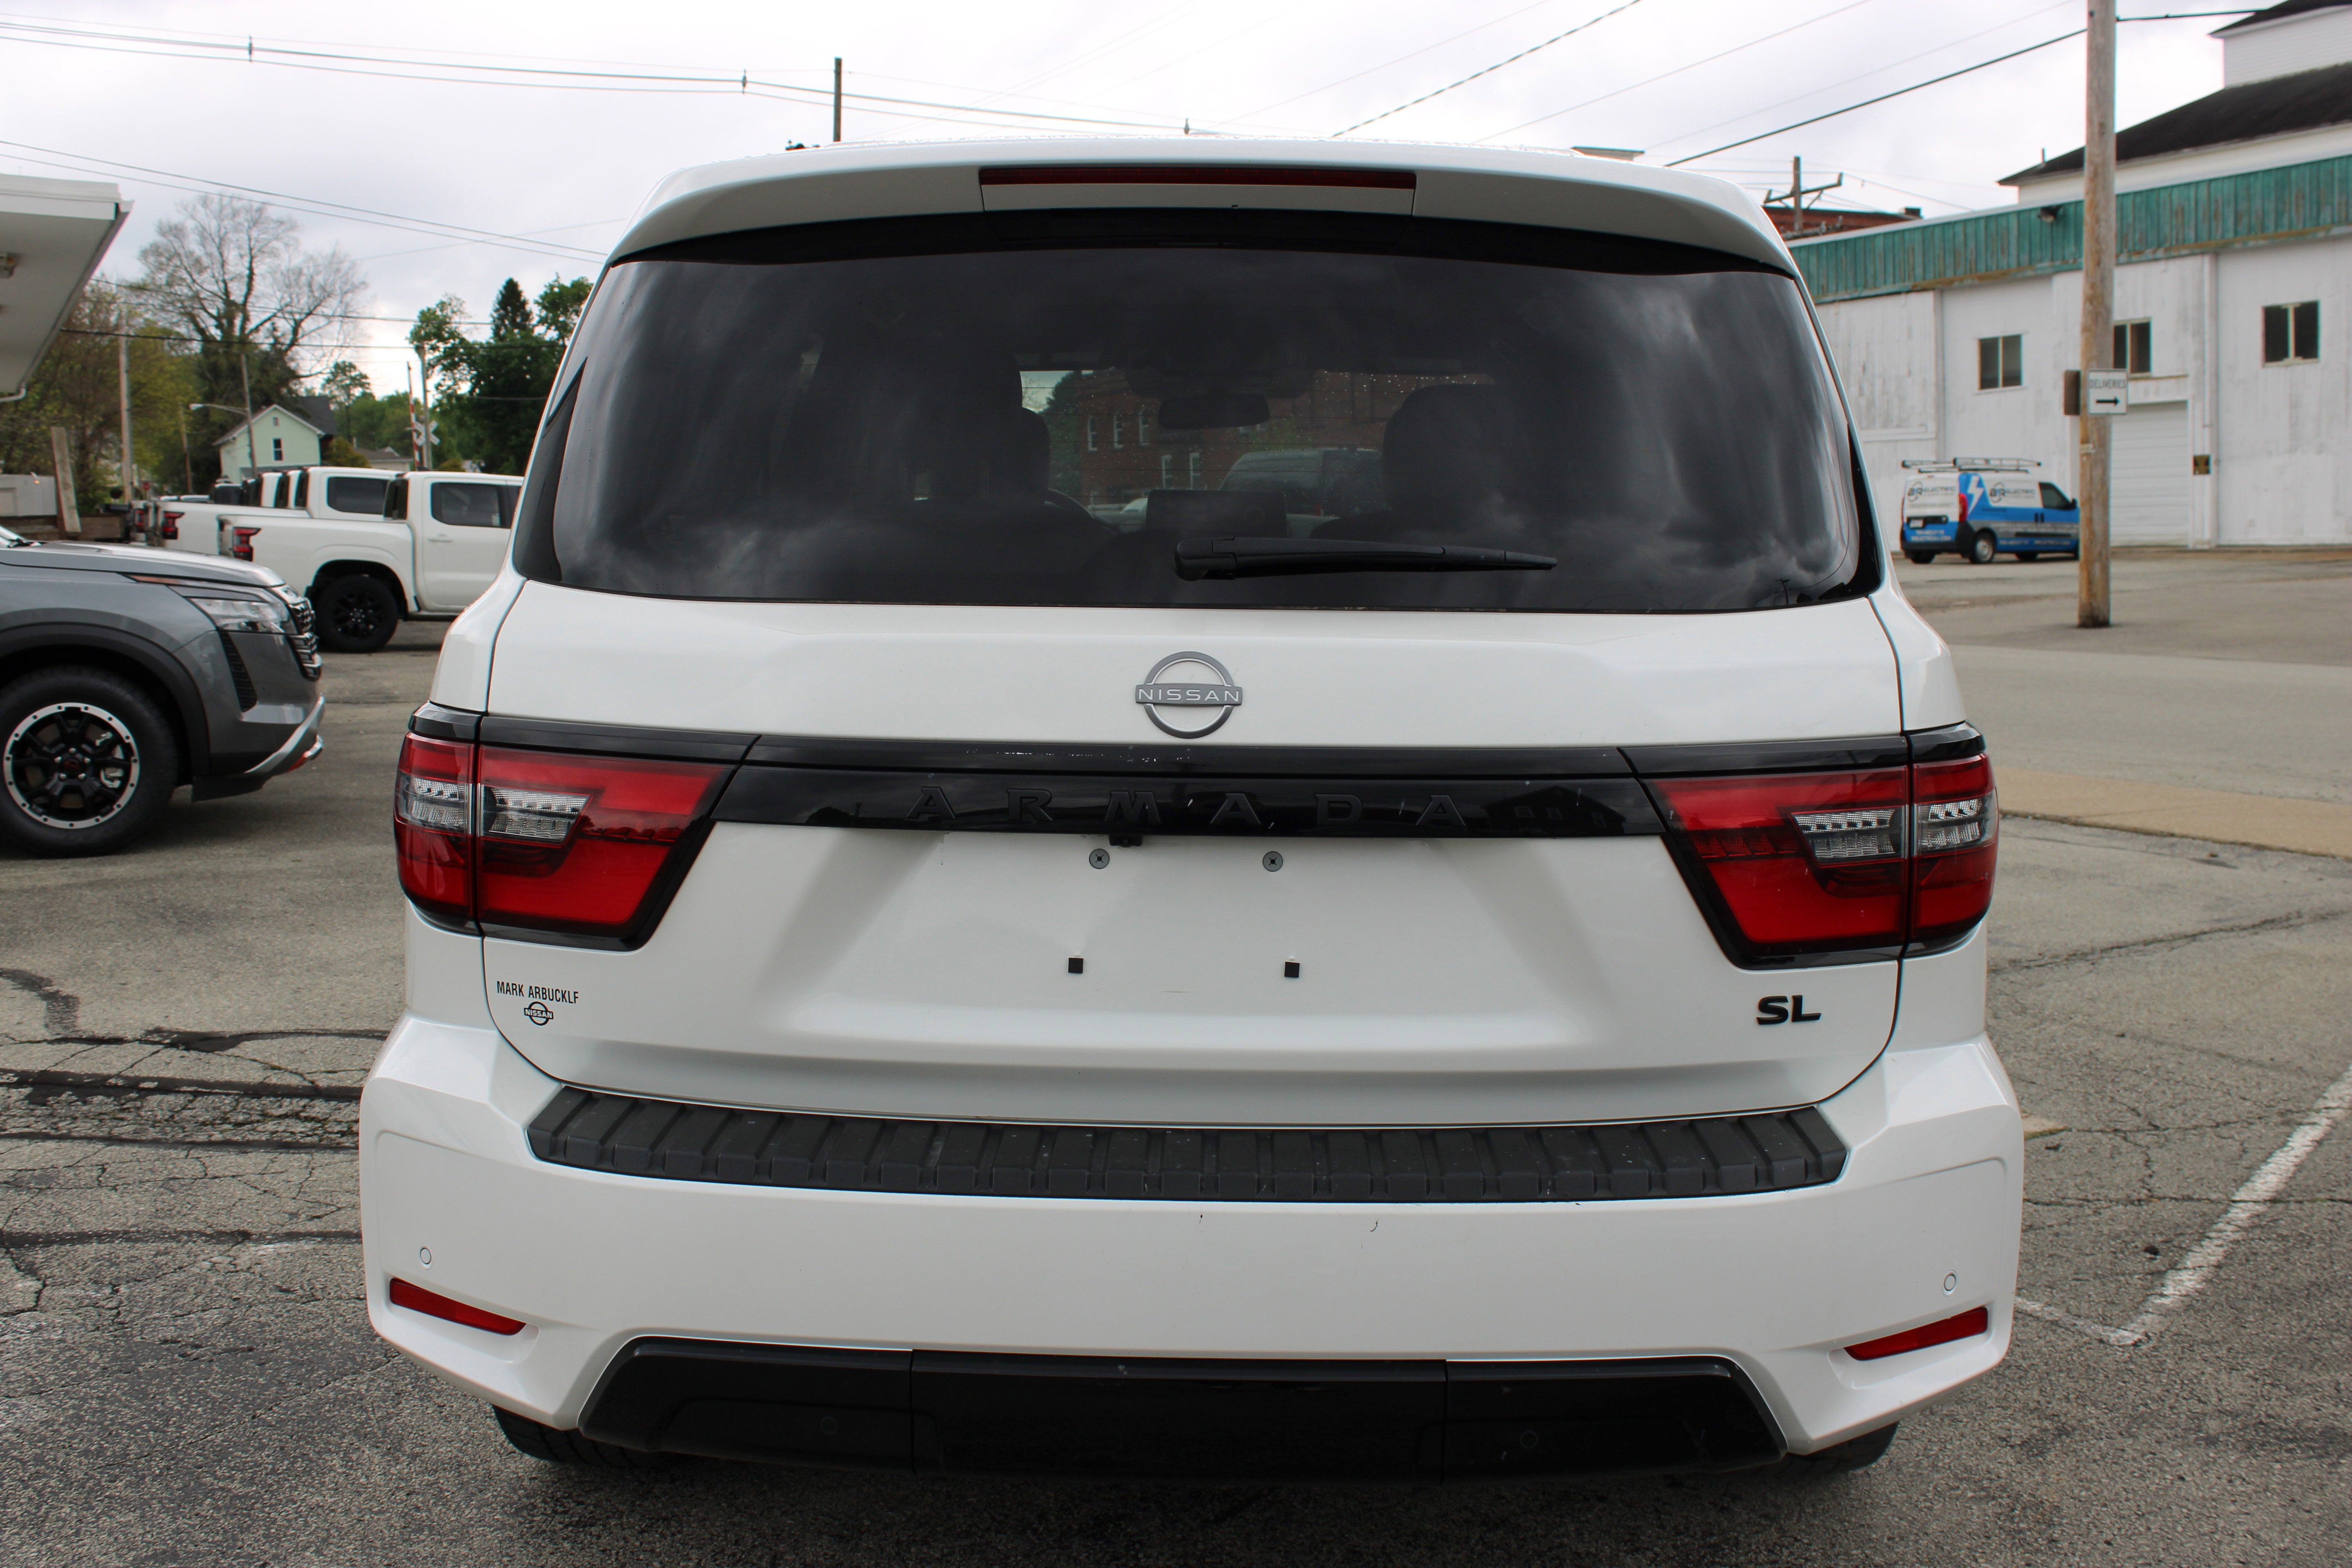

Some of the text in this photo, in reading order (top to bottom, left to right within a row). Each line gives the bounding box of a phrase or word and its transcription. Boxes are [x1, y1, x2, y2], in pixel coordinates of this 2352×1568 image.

[2090, 379, 2127, 388] DELIVERIES
[1138, 688, 1239, 702] NISSAN
[906, 786, 1466, 826] ARMADA
[497, 981, 524, 997] MARK
[525, 1008, 552, 1019] NISSAN
[1756, 995, 1822, 1025] SL
